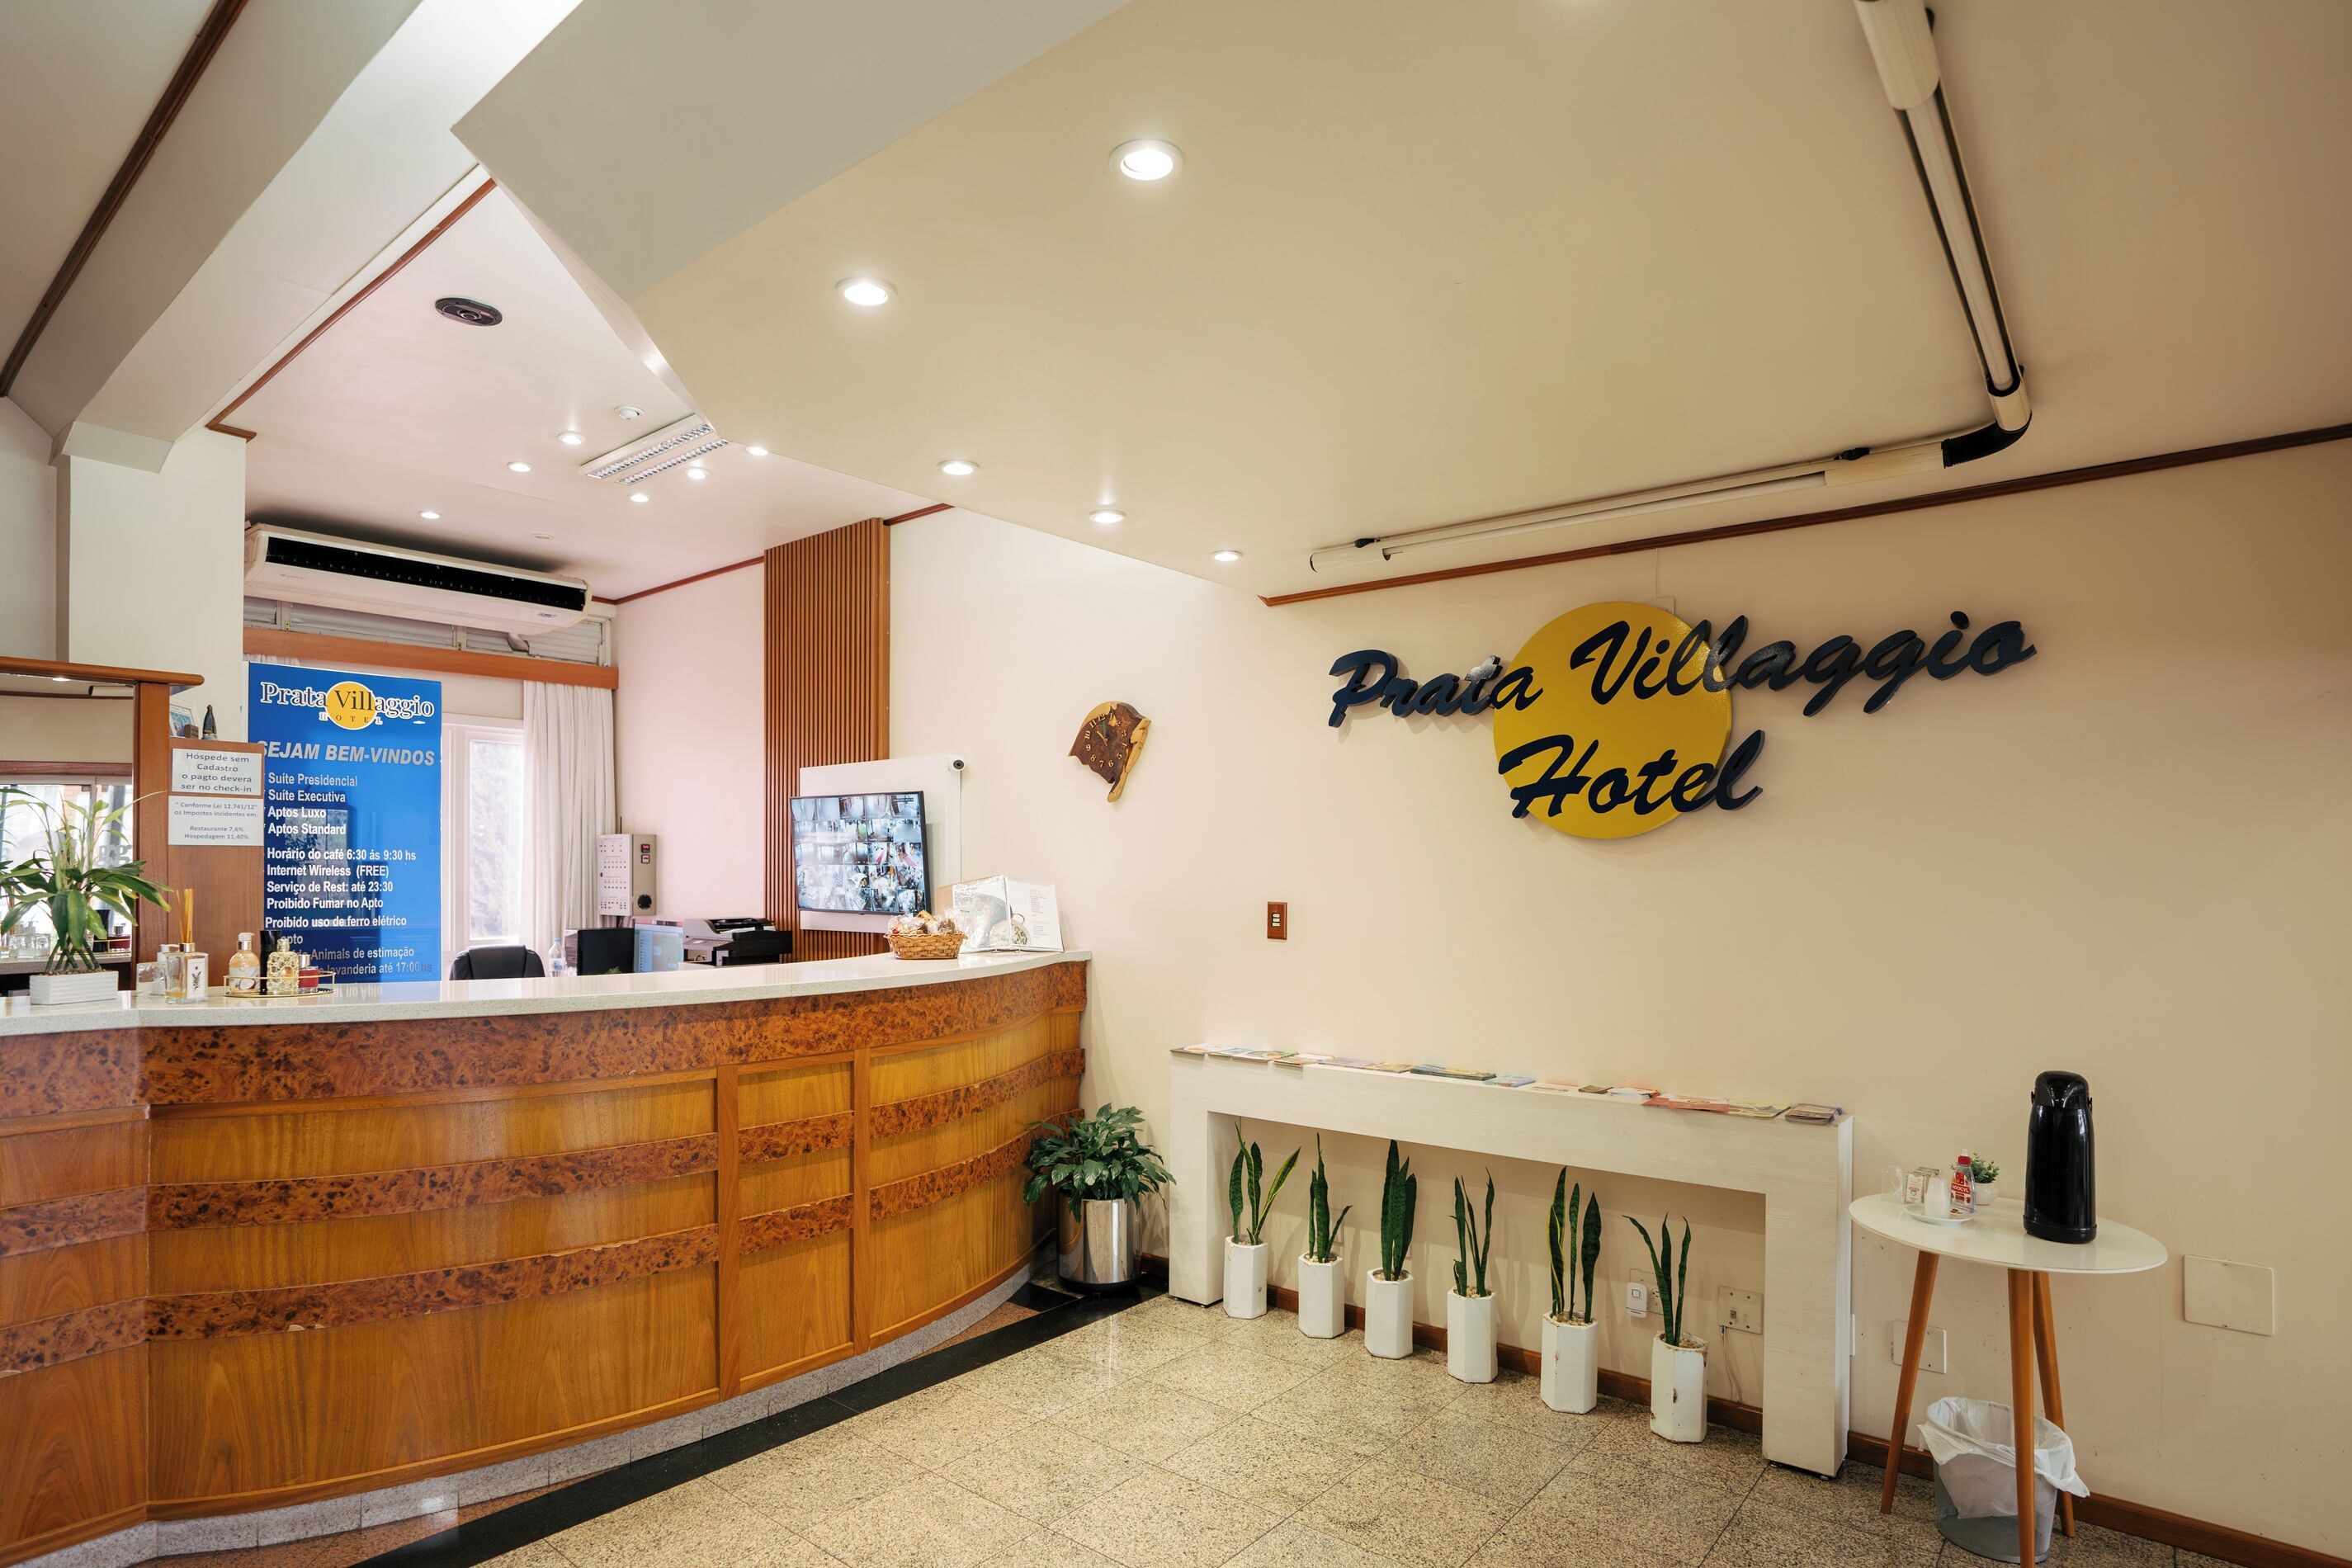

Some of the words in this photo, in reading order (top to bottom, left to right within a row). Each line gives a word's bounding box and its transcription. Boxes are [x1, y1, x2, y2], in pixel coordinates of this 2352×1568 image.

[1327, 649, 1544, 727] Prata
[1570, 612, 2038, 718] Villaggio
[260, 682, 328, 707] Prata
[334, 689, 434, 720] Villaggio
[1089, 720, 1097, 728] 11
[1084, 730, 1090, 739] 10
[186, 753, 228, 762] Hóspede
[324, 744, 436, 767] BEM-VINDOS
[196, 763, 239, 772] Cadastro
[191, 774, 218, 782] pagto
[268, 772, 295, 785] Suíte
[298, 773, 358, 786] Presidencial
[1498, 730, 1765, 819] Hotel
[213, 784, 252, 792] check-in
[268, 789, 295, 801] Suíte
[297, 790, 347, 802] Executiva
[267, 807, 299, 819] Aptos
[301, 808, 327, 819] Luxo
[267, 823, 299, 835] Aptos
[300, 824, 347, 835] Standard
[267, 848, 305, 860] Horário
[308, 848, 321, 860] do
[323, 848, 344, 860] café
[347, 849, 367, 860] 6:30
[369, 849, 380, 861] ás
[383, 850, 403, 861] 9:30
[404, 849, 417, 861] hs
[267, 864, 306, 876] Internet
[308, 865, 351, 876] Wireless
[356, 865, 390, 878] (FREE)
[267, 881, 306, 895] Serviço
[308, 881, 321, 892] de
[323, 881, 348, 892] Rest:
[351, 881, 366, 892] até
[368, 881, 393, 892] 23:30
[267, 898, 311, 909] Proibido
[313, 898, 345, 909] Fumar
[346, 900, 359, 909] no
[361, 897, 384, 910] Apto
[265, 917, 309, 928] Proibido
[311, 919, 331, 927] uso
[333, 916, 345, 927] de
[346, 916, 370, 927] ferro
[372, 916, 407, 927] elétrico
[281, 933, 304, 944] pto
[310, 948, 351, 960] Animais
[353, 948, 366, 959] de
[366, 947, 414, 960] estimação
[379, 962, 393, 973] até
[395, 961, 419, 973] 17:00
[422, 962, 432, 971] hs
